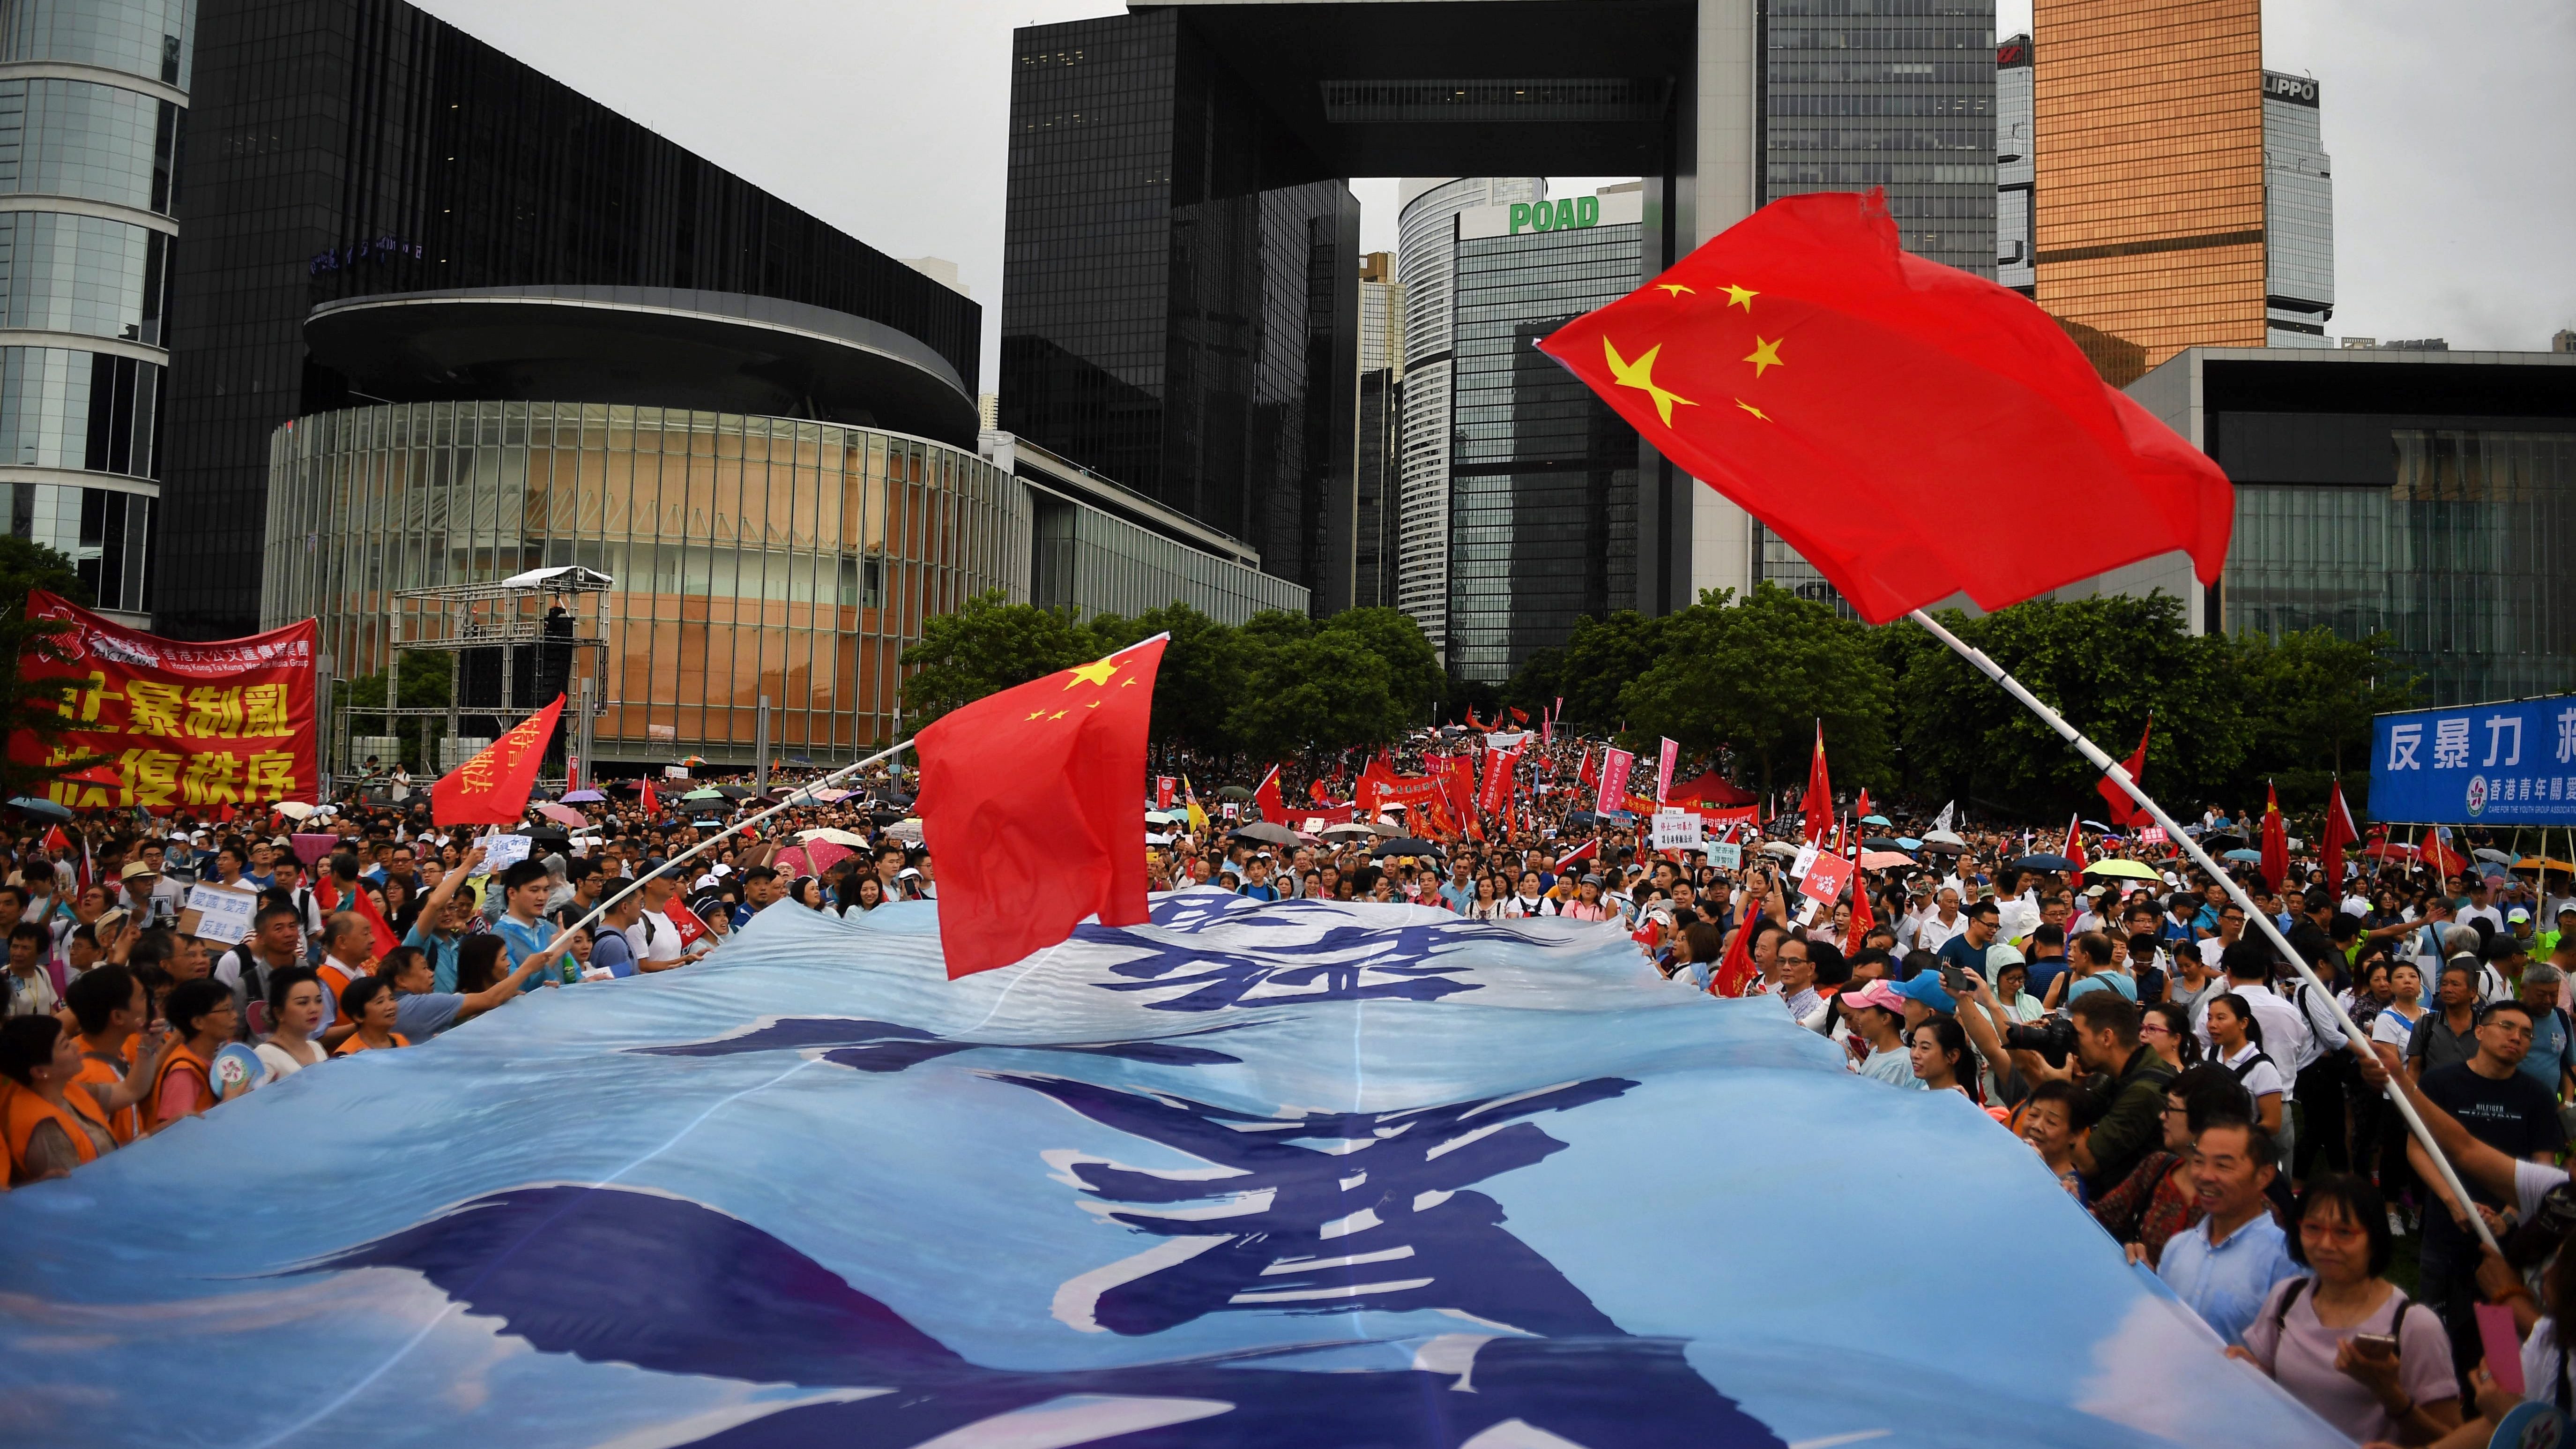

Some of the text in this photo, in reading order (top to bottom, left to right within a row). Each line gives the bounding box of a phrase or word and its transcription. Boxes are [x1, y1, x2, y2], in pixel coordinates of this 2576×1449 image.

[2263, 75, 2314, 100] LIPPO
[1510, 196, 1599, 235] POAD
[171, 662, 192, 672] Hong
[191, 664, 212, 673] Kong
[223, 663, 245, 672] Kung
[290, 658, 308, 668] Group
[2387, 715, 2522, 771] 反暴力
[1660, 822, 1692, 832] 停止一切暴力
[1715, 846, 1734, 855] 愛香港
[192, 891, 251, 914] 愛國 愛港
[199, 920, 227, 936] 反對
[2476, 1103, 2504, 1113] HILFIGER
